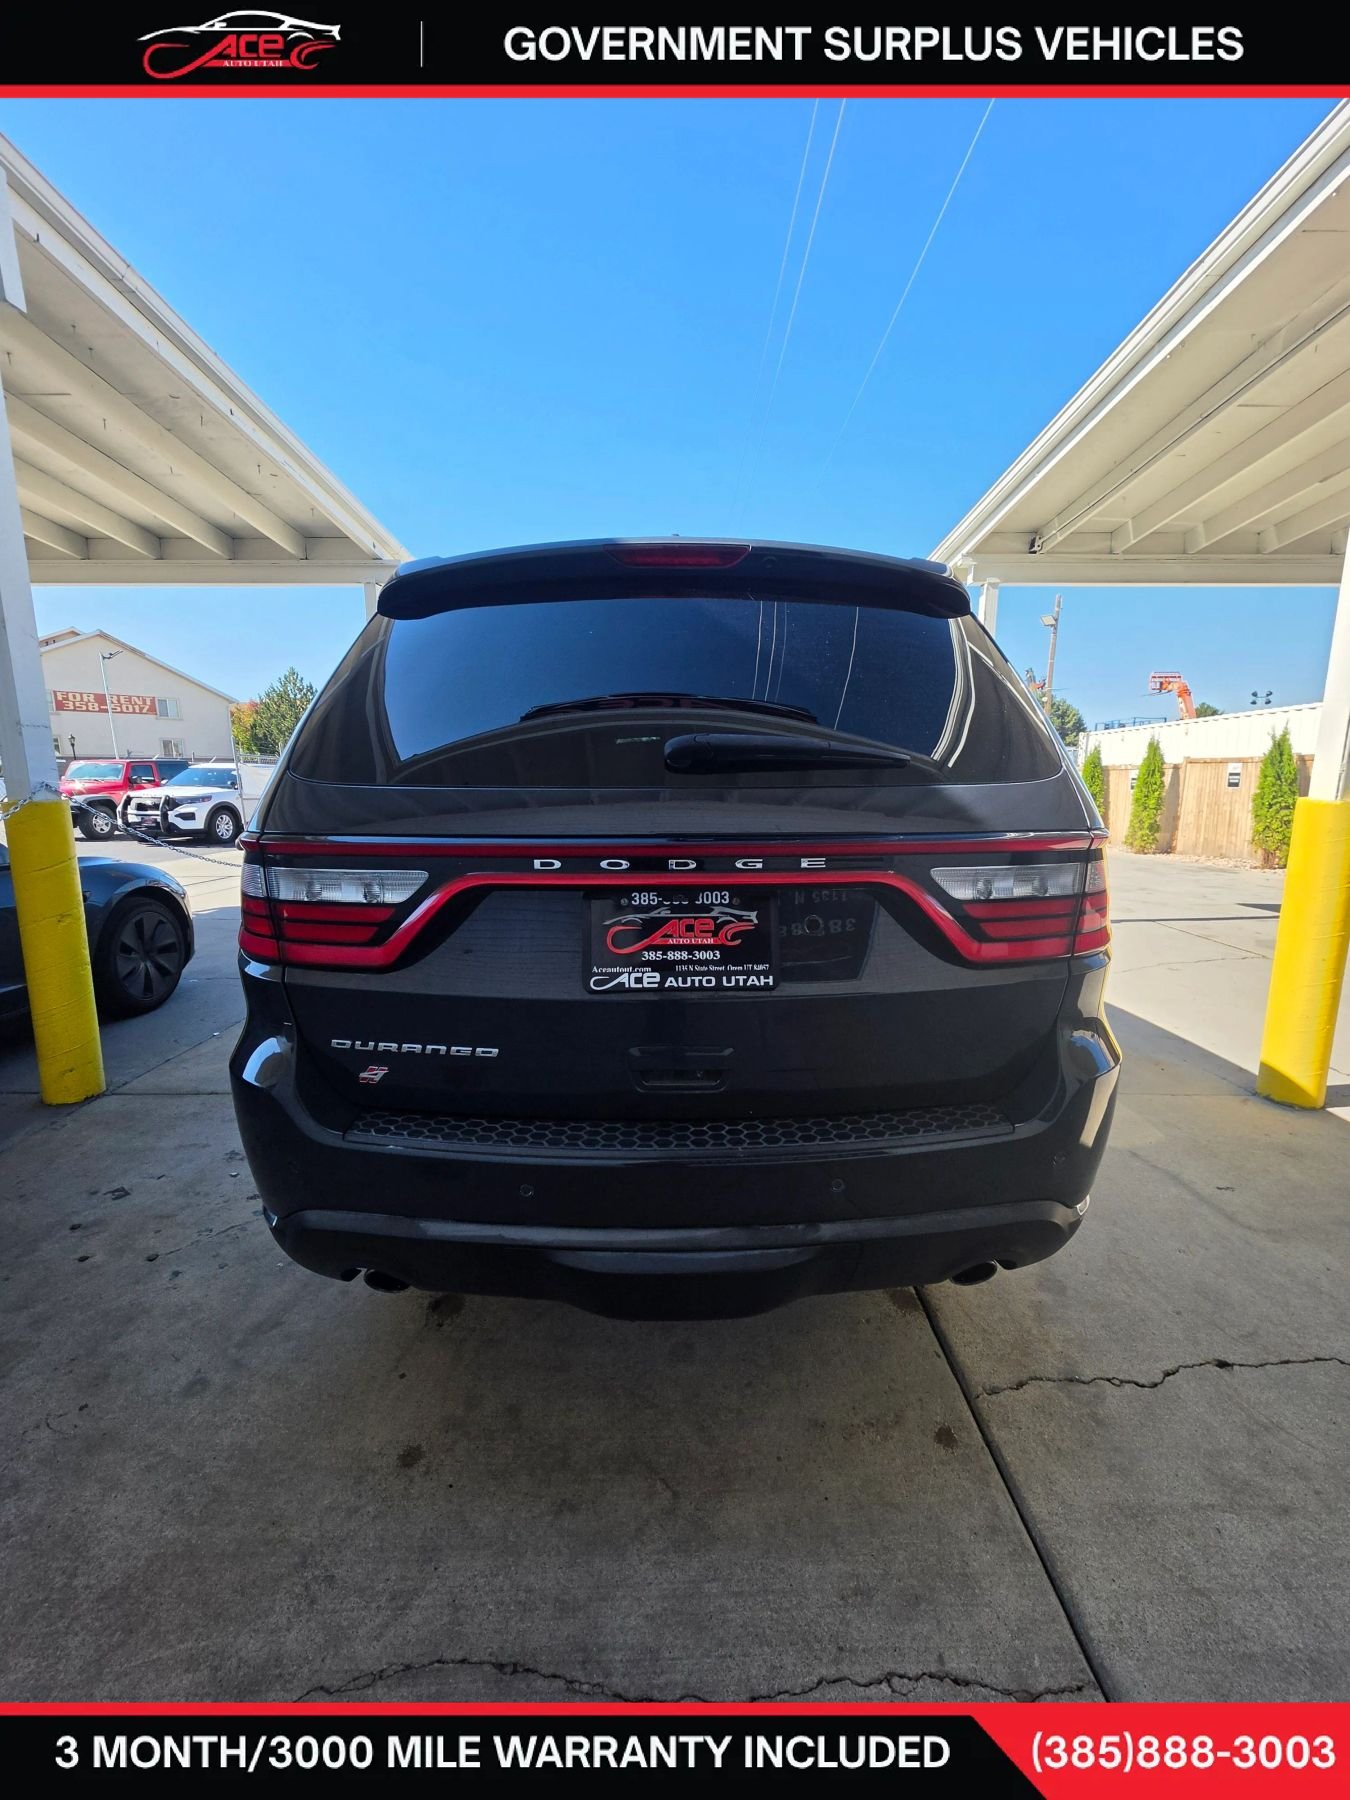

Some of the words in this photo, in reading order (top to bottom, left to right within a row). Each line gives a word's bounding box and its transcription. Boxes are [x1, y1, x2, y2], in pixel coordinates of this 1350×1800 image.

[56, 691, 96, 703] FOR
[109, 694, 153, 706] RENT
[62, 701, 150, 713] 358-5017
[533, 857, 826, 870] DODGE
[641, 950, 721, 961] 385-888-3003
[664, 976, 716, 988] AUTO
[722, 975, 774, 987] UTAH
[331, 1039, 499, 1057] DURANGO
